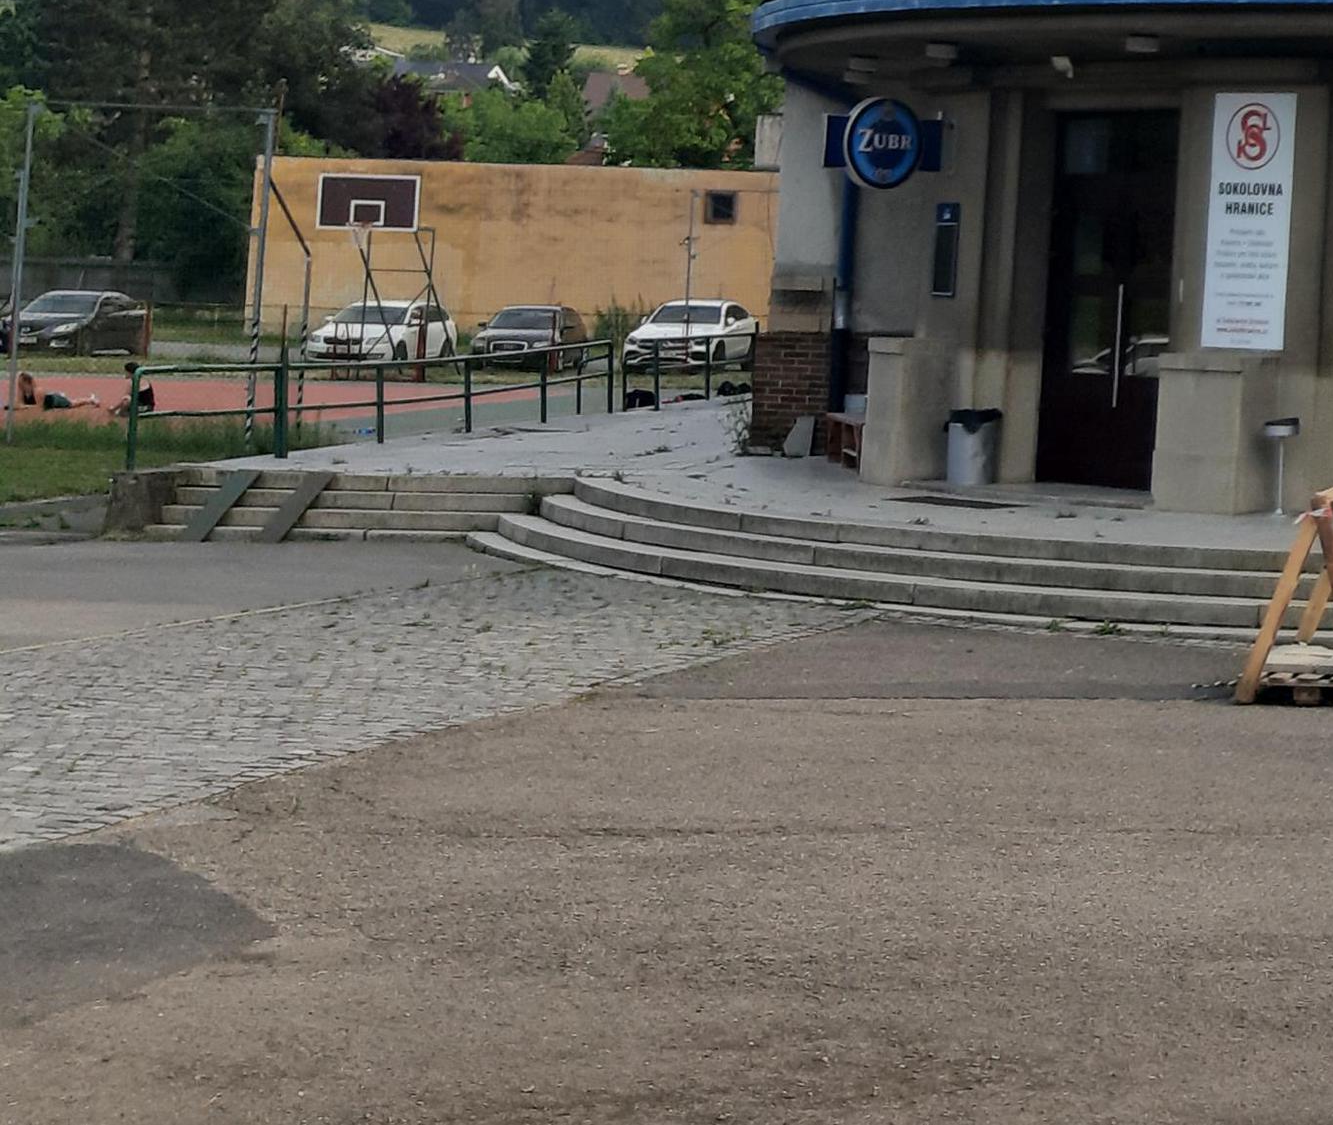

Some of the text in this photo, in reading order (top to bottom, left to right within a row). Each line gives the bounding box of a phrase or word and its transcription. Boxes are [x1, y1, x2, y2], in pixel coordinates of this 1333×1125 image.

[857, 128, 912, 152] ZUBR
[1218, 181, 1283, 196] SOKOLOVNA
[1225, 201, 1274, 215] HRANICE
